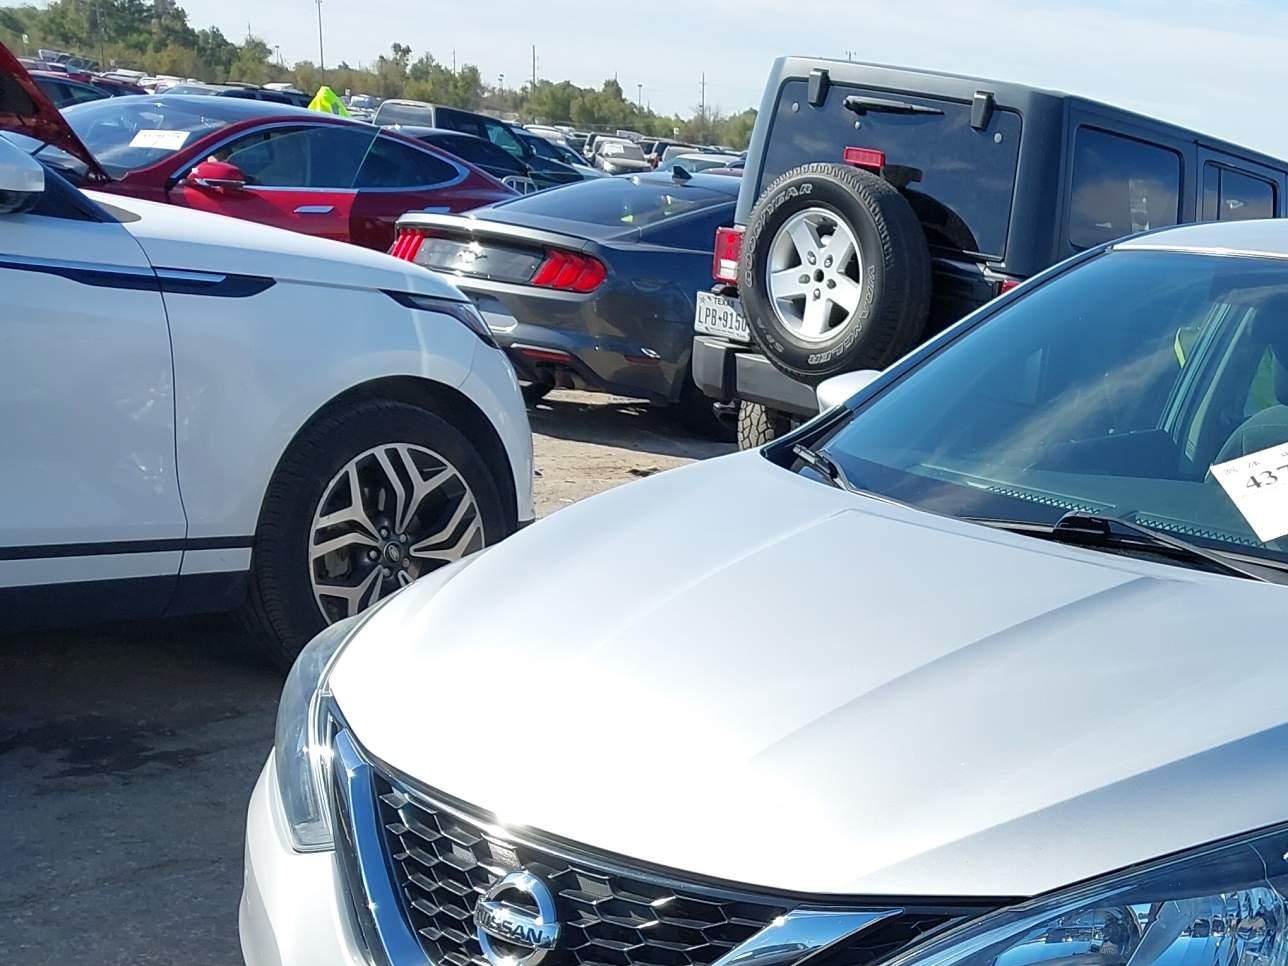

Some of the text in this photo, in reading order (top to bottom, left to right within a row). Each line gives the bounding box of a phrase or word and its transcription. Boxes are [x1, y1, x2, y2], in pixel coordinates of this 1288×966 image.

[745, 183, 813, 287] GOODYEAR
[807, 265, 876, 365] WRANGLER
[477, 908, 543, 944] NISSAN
